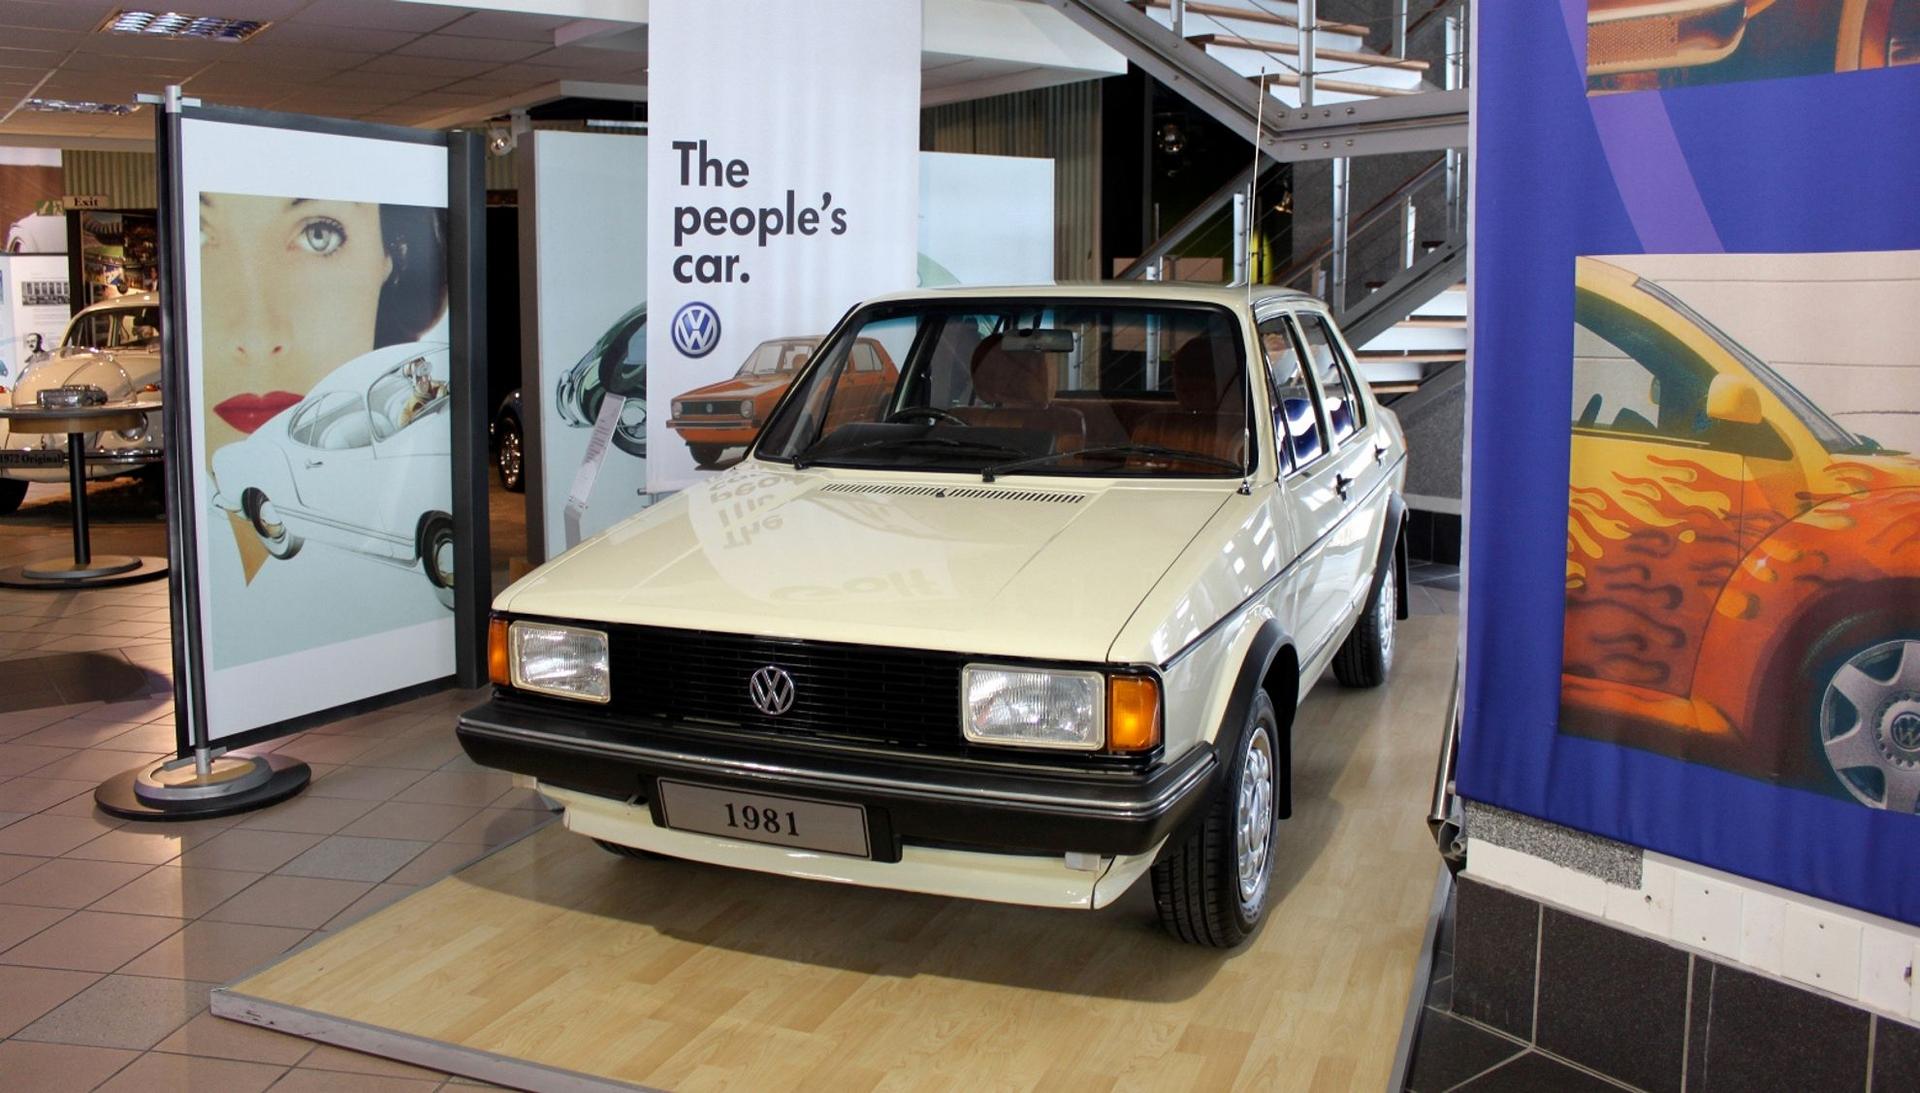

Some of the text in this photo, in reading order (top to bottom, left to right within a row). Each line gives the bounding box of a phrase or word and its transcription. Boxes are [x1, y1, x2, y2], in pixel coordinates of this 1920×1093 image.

[672, 140, 749, 188] The
[74, 197, 98, 207] Exit
[674, 190, 847, 247] people’s
[673, 255, 750, 284] car.
[725, 803, 799, 837] 1981
